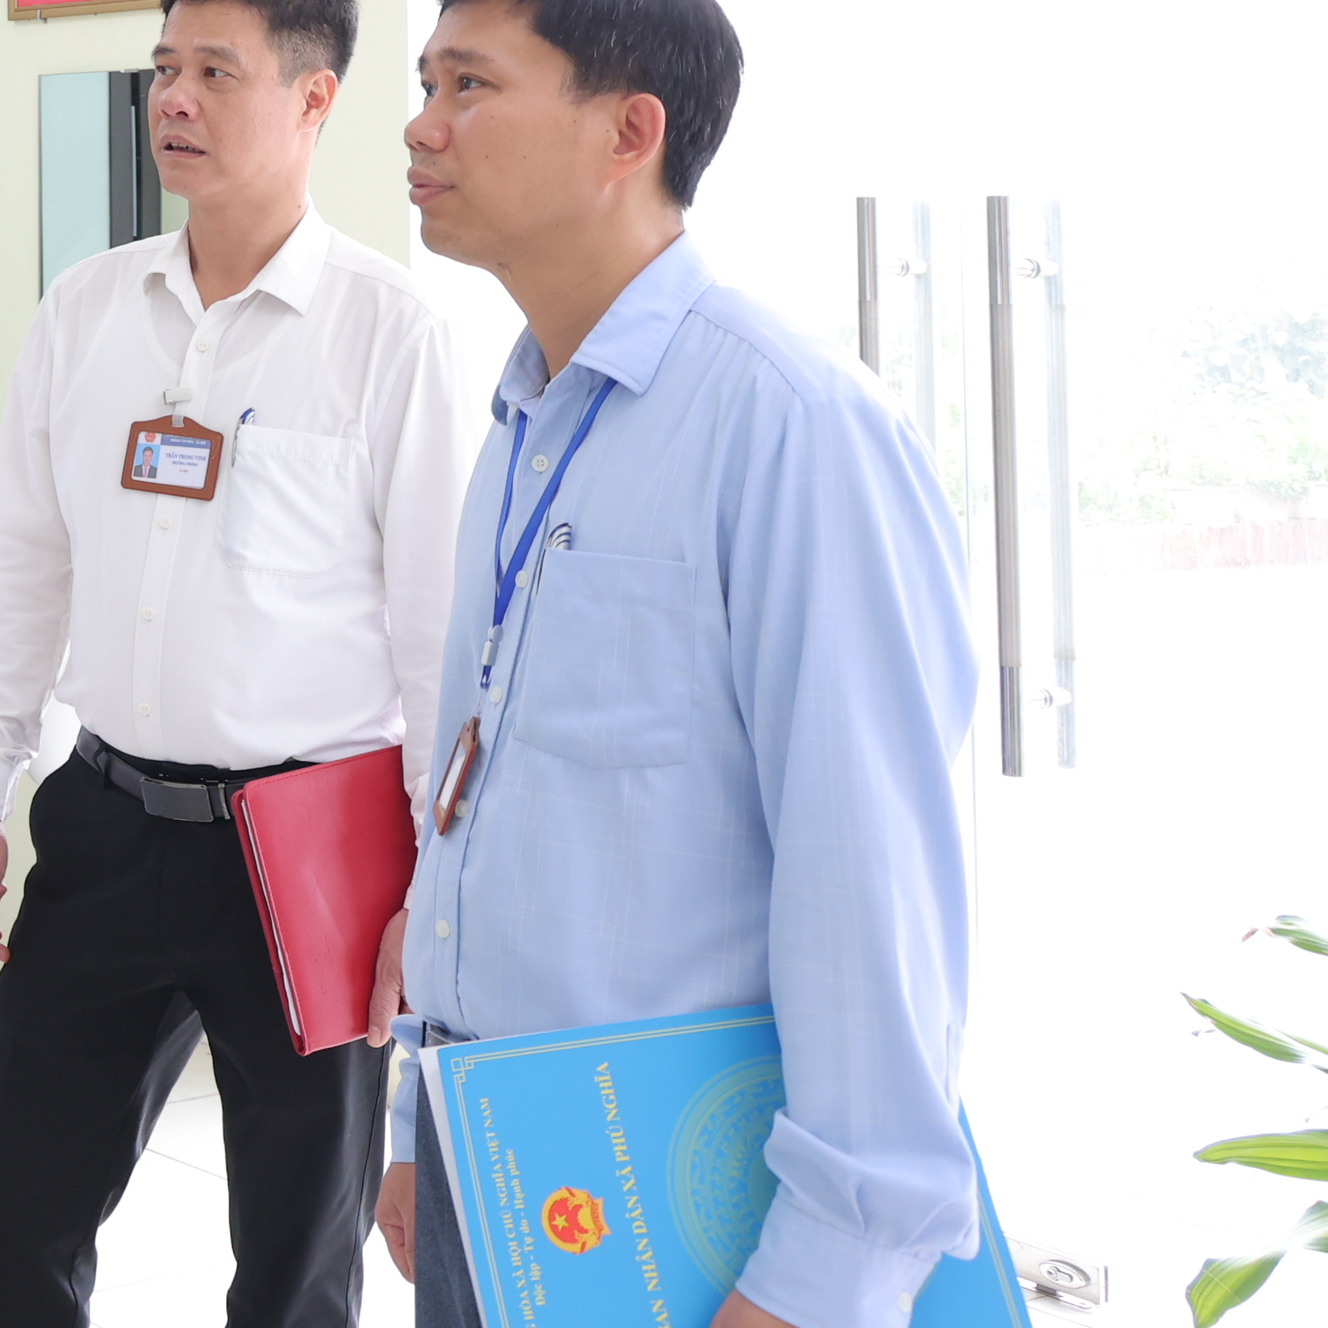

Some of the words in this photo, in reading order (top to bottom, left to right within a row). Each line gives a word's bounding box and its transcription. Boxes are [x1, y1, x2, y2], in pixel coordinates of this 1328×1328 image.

[595, 1062, 620, 1121] NGHĨA
[480, 1098, 493, 1127] NAM
[486, 1131, 500, 1161] VIỆT
[606, 1126, 630, 1161] PHÚ
[492, 1163, 509, 1206] NGHĨA
[616, 1166, 637, 1191] XÃ
[500, 1209, 516, 1238] CHỦ
[625, 1196, 648, 1234] DÂN
[508, 1241, 522, 1266] HỘI
[636, 1238, 662, 1291] NHÂN
[513, 1269, 526, 1288] XÃ
[519, 1290, 534, 1320] HÒA
